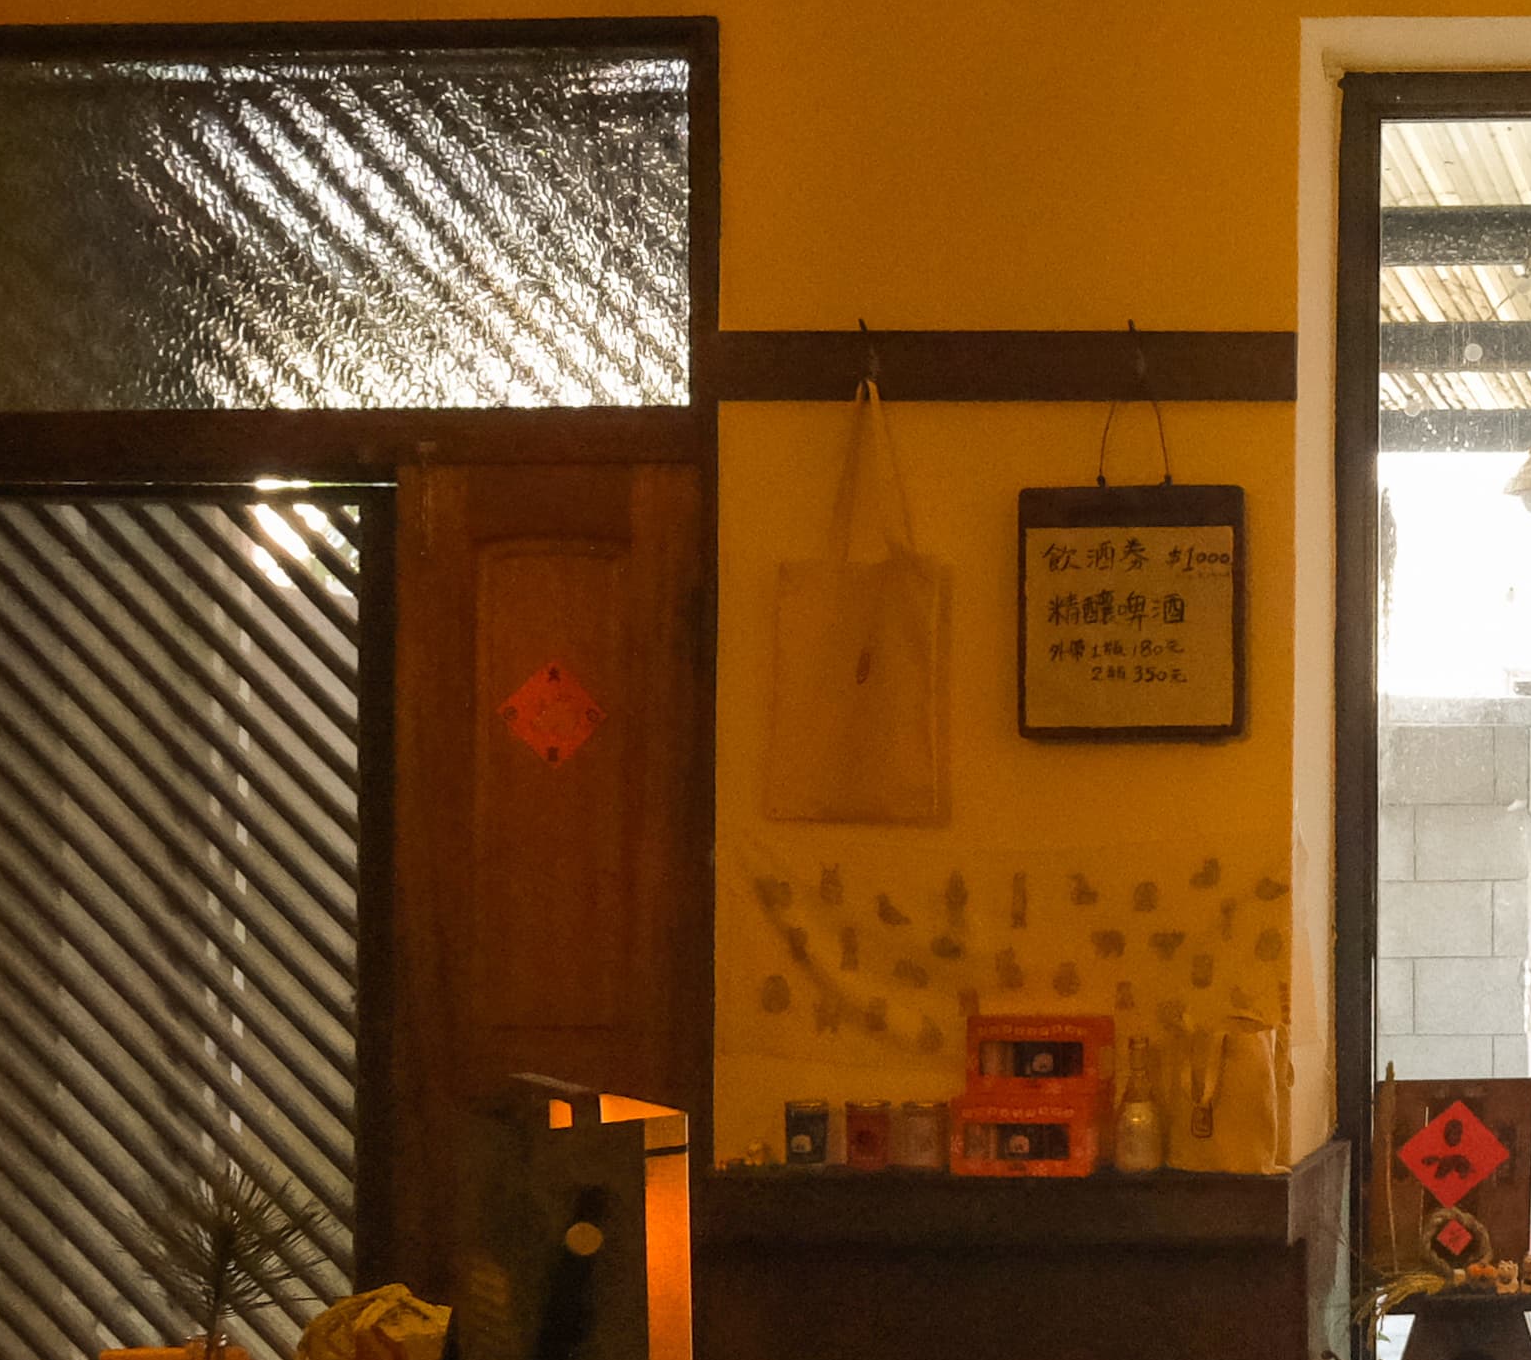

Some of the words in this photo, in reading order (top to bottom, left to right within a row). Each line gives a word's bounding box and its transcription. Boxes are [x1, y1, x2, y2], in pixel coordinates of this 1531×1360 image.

[1166, 545, 1231, 571] $1000
[1048, 589, 1186, 631] 精釀啤酒
